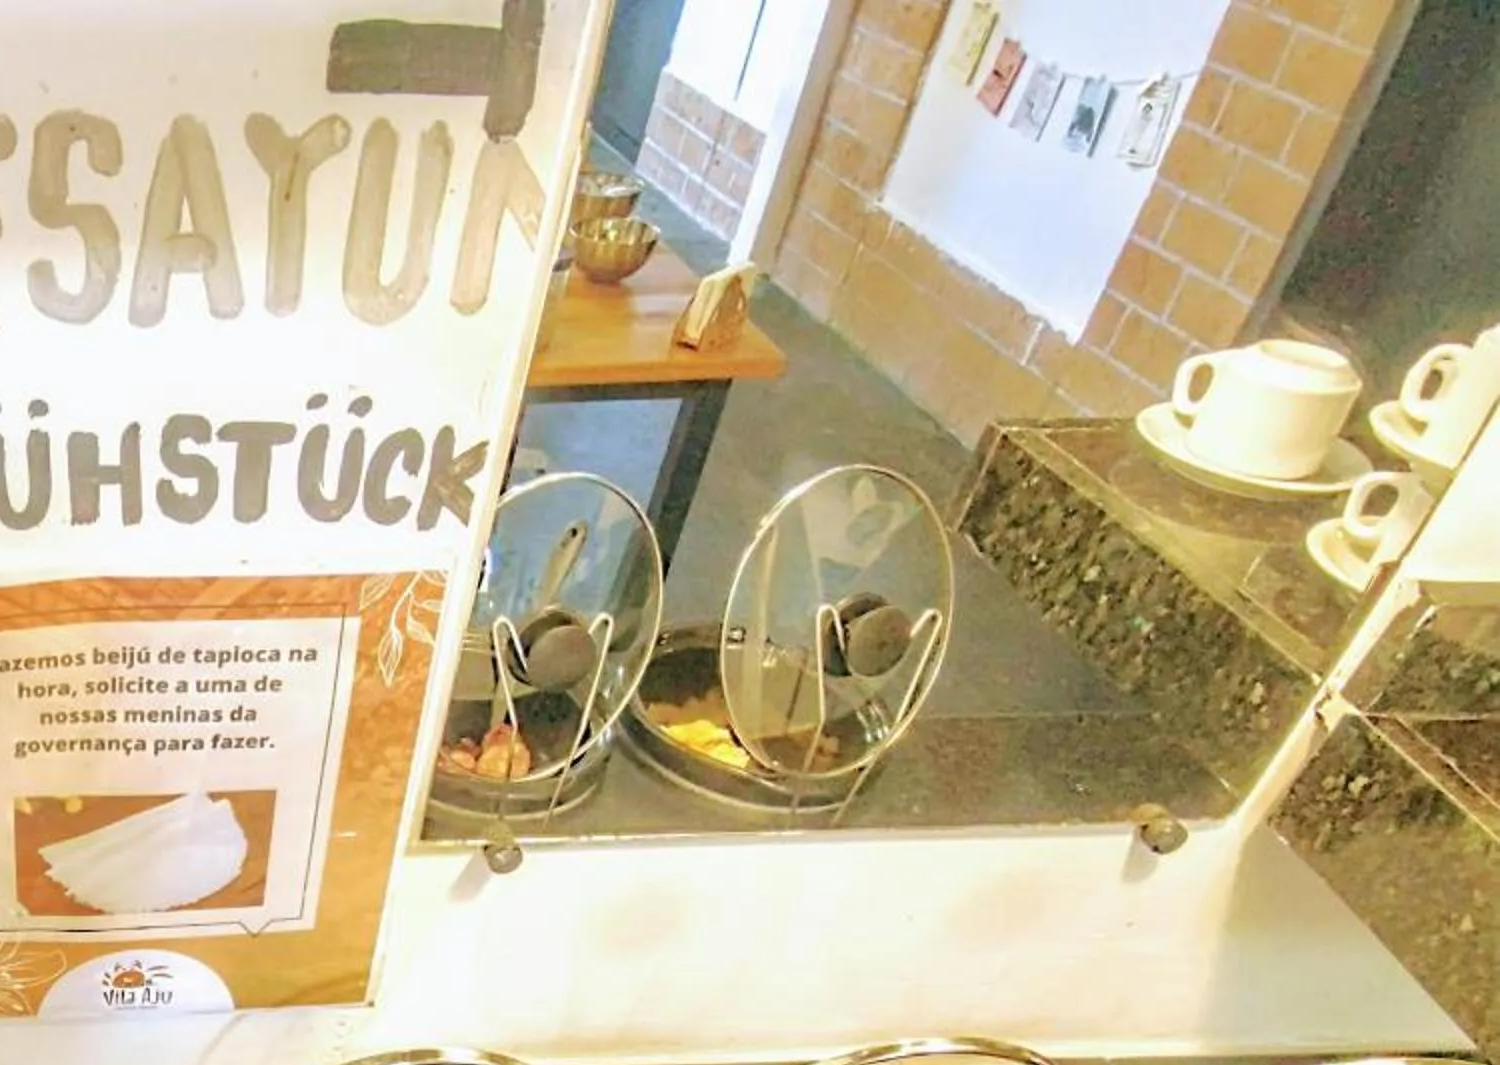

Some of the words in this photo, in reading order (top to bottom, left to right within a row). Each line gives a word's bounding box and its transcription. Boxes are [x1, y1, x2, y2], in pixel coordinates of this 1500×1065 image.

[92, 646, 150, 669] beijú
[157, 646, 186, 664] de
[193, 645, 281, 667] tapioca
[288, 648, 318, 663] na
[17, 682, 78, 699] hora,
[85, 677, 169, 695] solicite
[175, 680, 189, 694] a
[195, 679, 247, 693] uma
[254, 675, 283, 693] de
[39, 708, 117, 726] nossas
[123, 704, 223, 724] meninas
[229, 704, 257, 723] da
[14, 737, 147, 758] governança
[153, 735, 204, 756] para
[211, 733, 276, 751] fazer.
